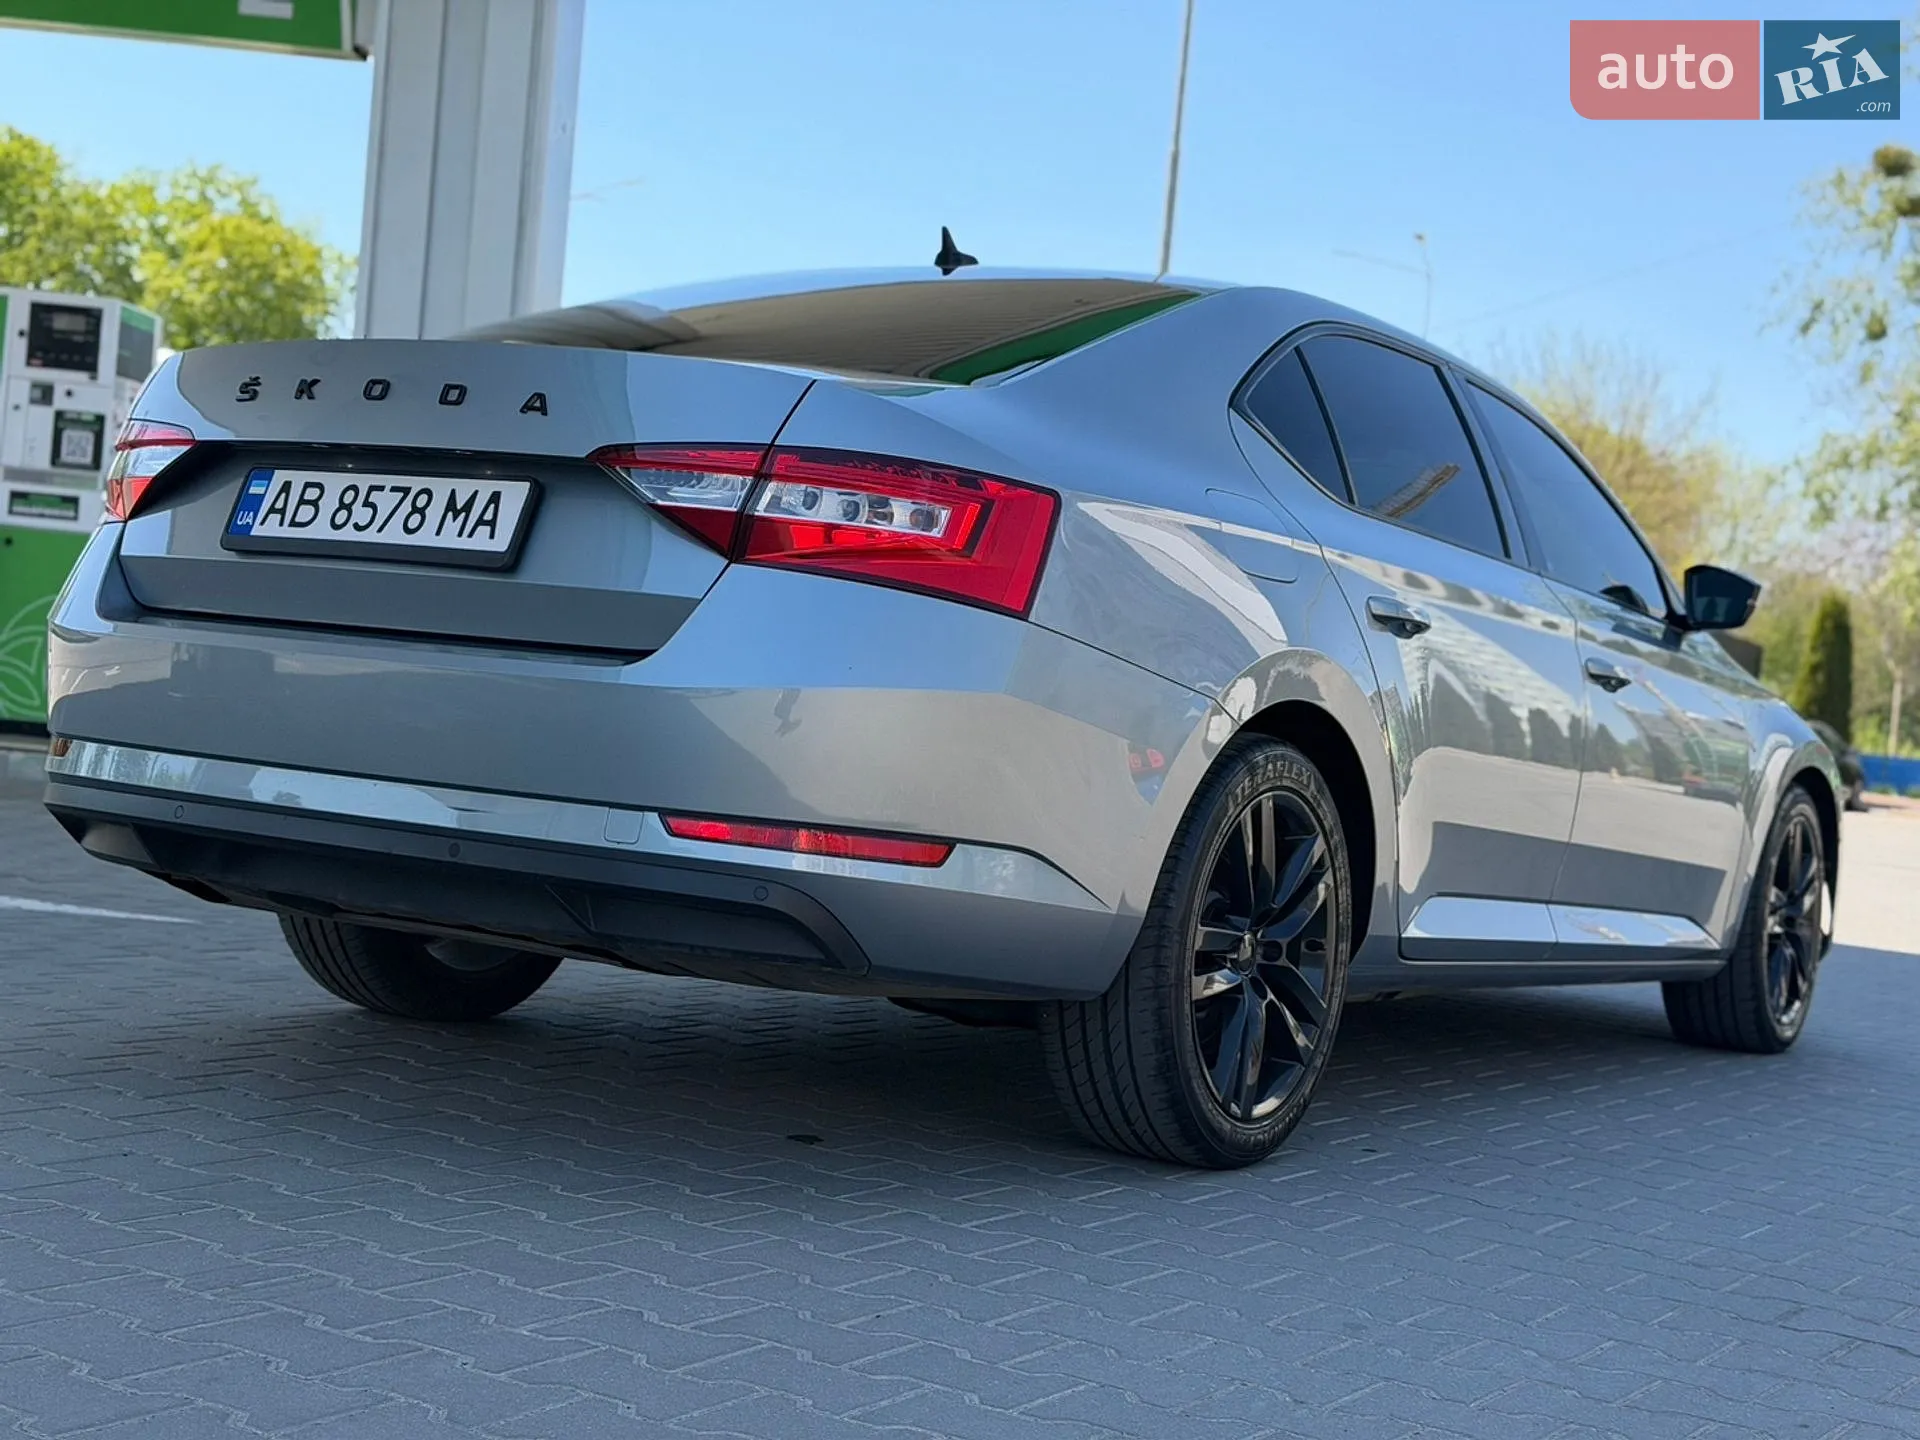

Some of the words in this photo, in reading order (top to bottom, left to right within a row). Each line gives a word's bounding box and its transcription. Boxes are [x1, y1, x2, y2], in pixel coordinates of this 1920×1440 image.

[235, 376, 549, 416] ŠKODA
[236, 510, 254, 526] UA
[259, 480, 326, 529] AB
[329, 484, 434, 535] 8578
[436, 489, 502, 539] MA
